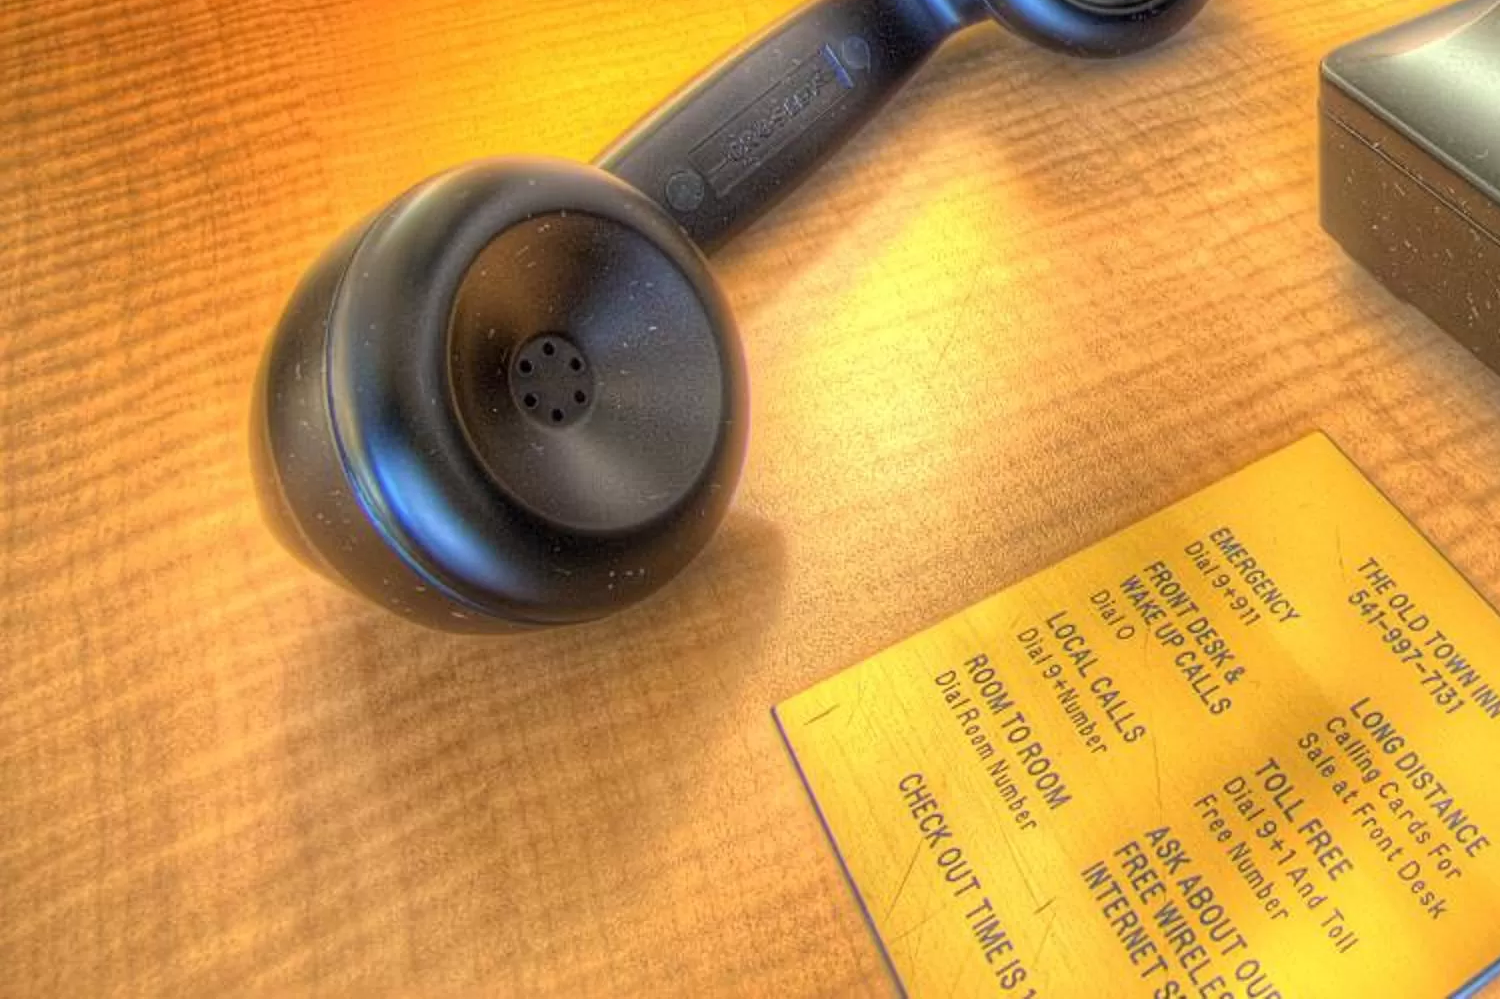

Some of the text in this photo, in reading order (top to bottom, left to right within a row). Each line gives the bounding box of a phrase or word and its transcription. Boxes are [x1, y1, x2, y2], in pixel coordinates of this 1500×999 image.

[1090, 589, 1124, 625] Dial
[1144, 561, 1245, 684] FRONT DESK &
[1184, 541, 1260, 626] Dial 9+911
[1209, 527, 1300, 622] EMERGENCY
[1358, 557, 1396, 595] THE
[1389, 594, 1429, 631] OLD
[1425, 630, 1480, 687] TOWN
[1017, 628, 1052, 665] Dial
[1047, 610, 1146, 743] LOCAL CALLS
[1120, 575, 1231, 714] WAKE UP CALLS
[1348, 589, 1464, 714] 541-997-7131
[935, 670, 1037, 830] Dial Room Number
[964, 654, 1072, 810] ROOM TO ROOM
[1350, 697, 1490, 857] LONG DISTANCE
[1194, 794, 1288, 920] Free Number
[1255, 757, 1353, 881] TOLL FREE
[1298, 732, 1447, 919] Sale at Front Desk
[1327, 717, 1461, 879] Calling Cards For
[899, 773, 1026, 990] CHECK OUT TIME IS
[1081, 861, 1168, 978] INTERNET
[1114, 841, 1167, 905] FREE
[1144, 827, 1191, 875] ASK
[1176, 875, 1248, 956] ABOUT
[1223, 777, 1358, 953] Dial 9+1 And Toll
